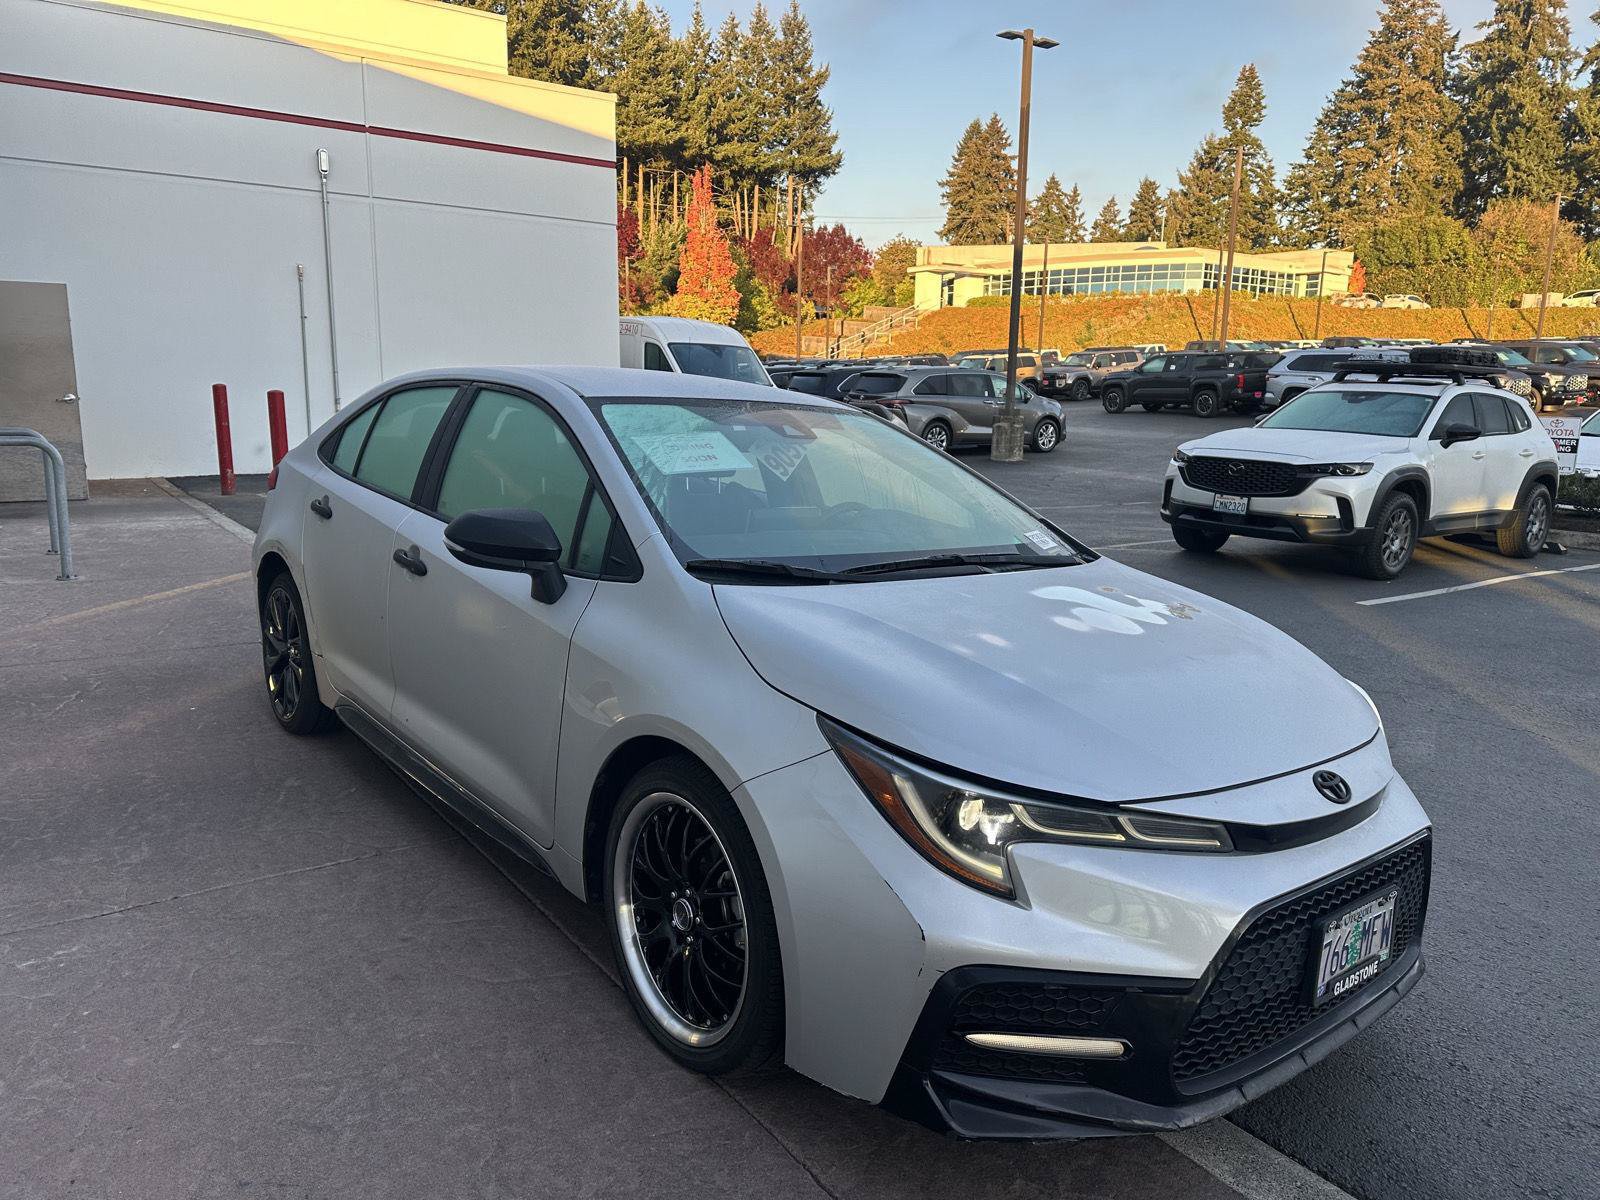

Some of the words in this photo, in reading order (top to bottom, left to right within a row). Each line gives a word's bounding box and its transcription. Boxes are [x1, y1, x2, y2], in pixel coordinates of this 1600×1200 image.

[1545, 428, 1575, 437] OYOTA
[1215, 500, 1246, 512] CMN2320
[1321, 930, 1350, 982] 766
[1359, 907, 1393, 958] MFW
[1334, 961, 1379, 996] GLADSTONE
